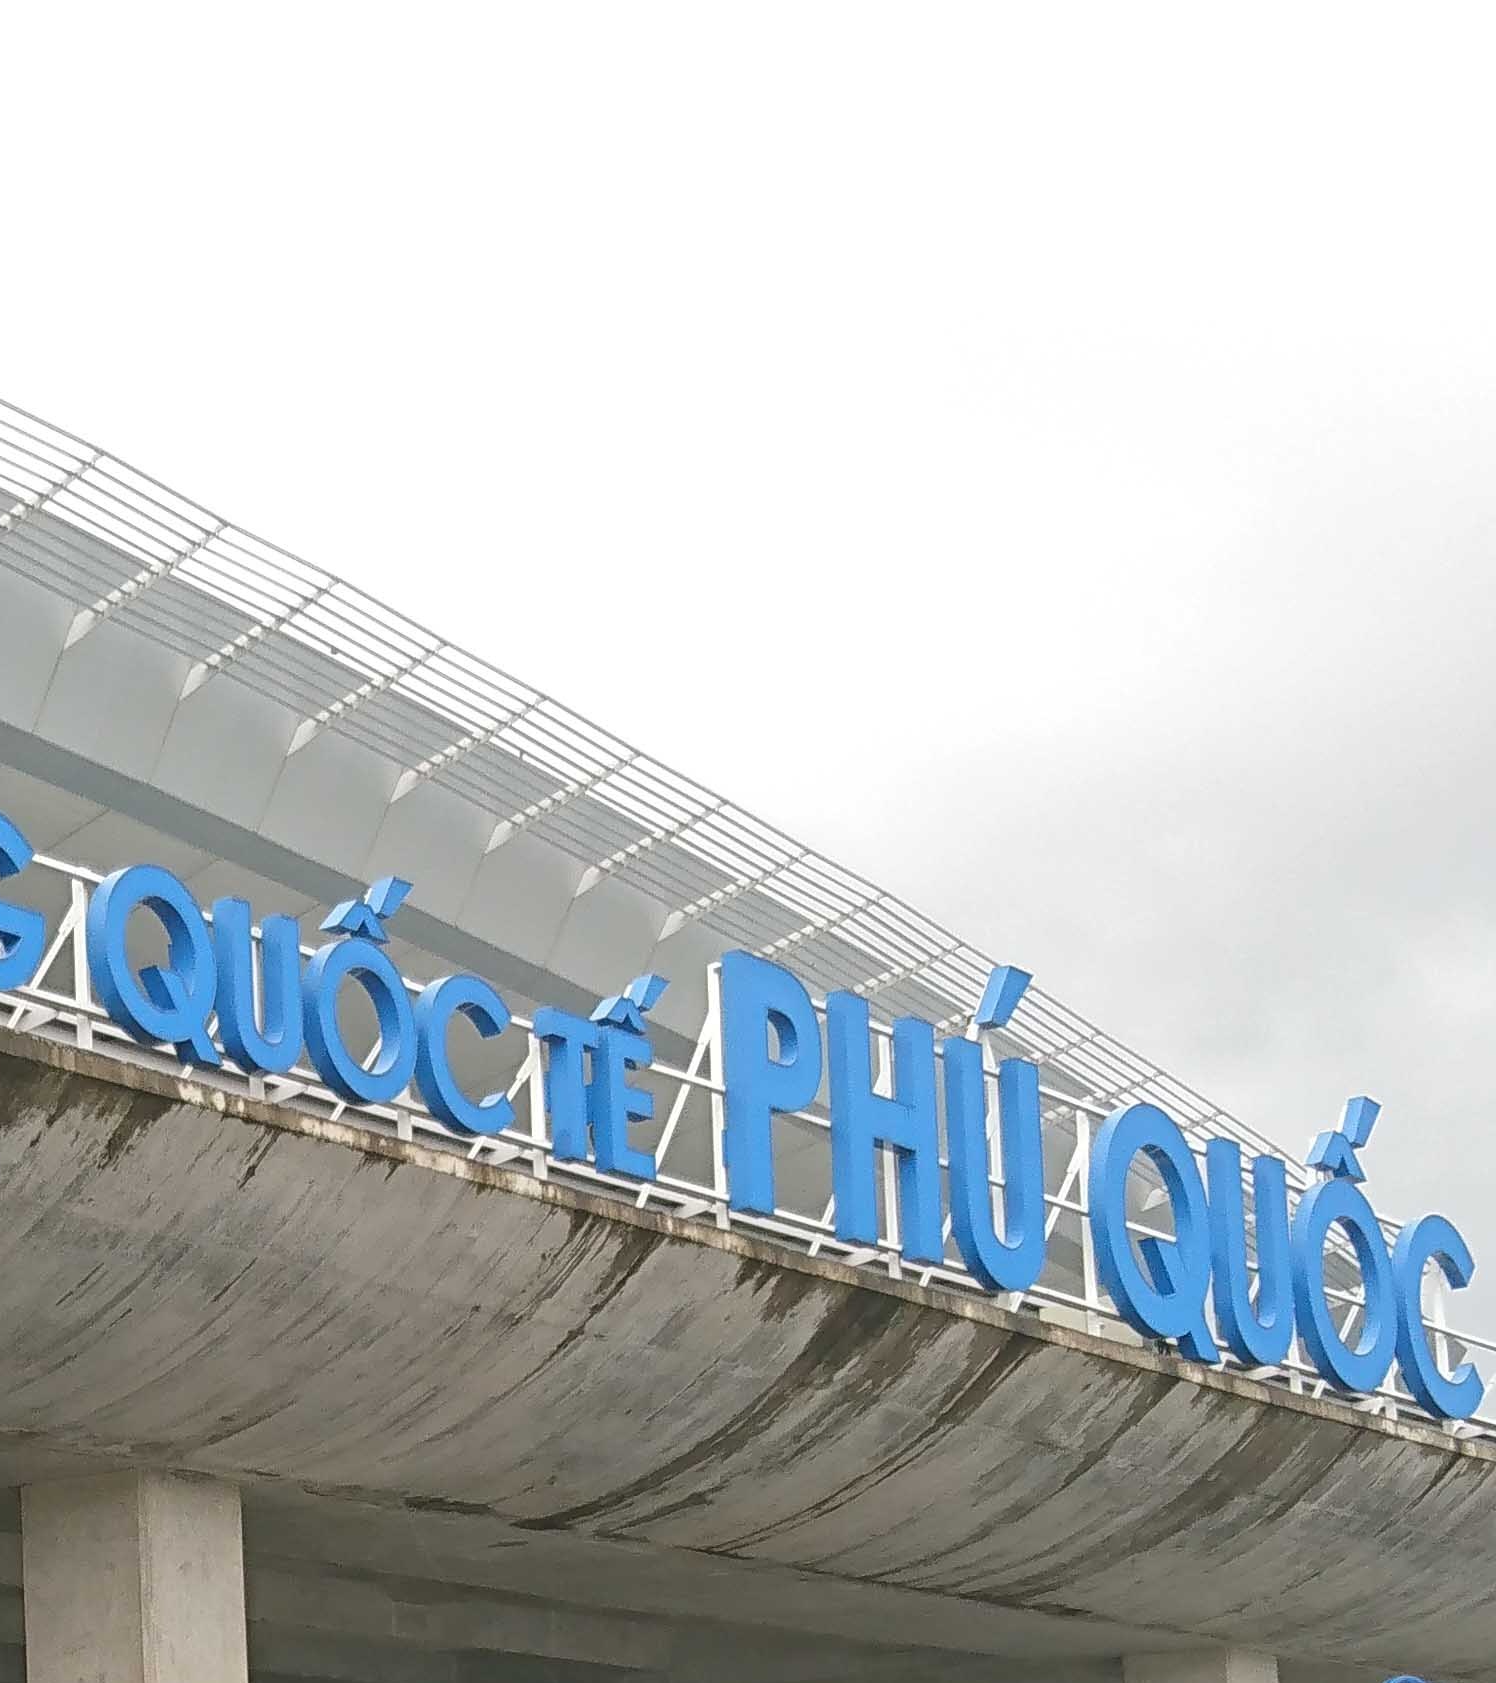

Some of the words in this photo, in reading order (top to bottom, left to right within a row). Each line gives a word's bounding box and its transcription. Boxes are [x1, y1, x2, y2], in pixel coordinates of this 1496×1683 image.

[87, 864, 515, 1135] QUỐC
[533, 973, 668, 1181] TẾ
[721, 950, 1046, 1293] PHÚ
[1089, 1094, 1484, 1420] QUỐC
